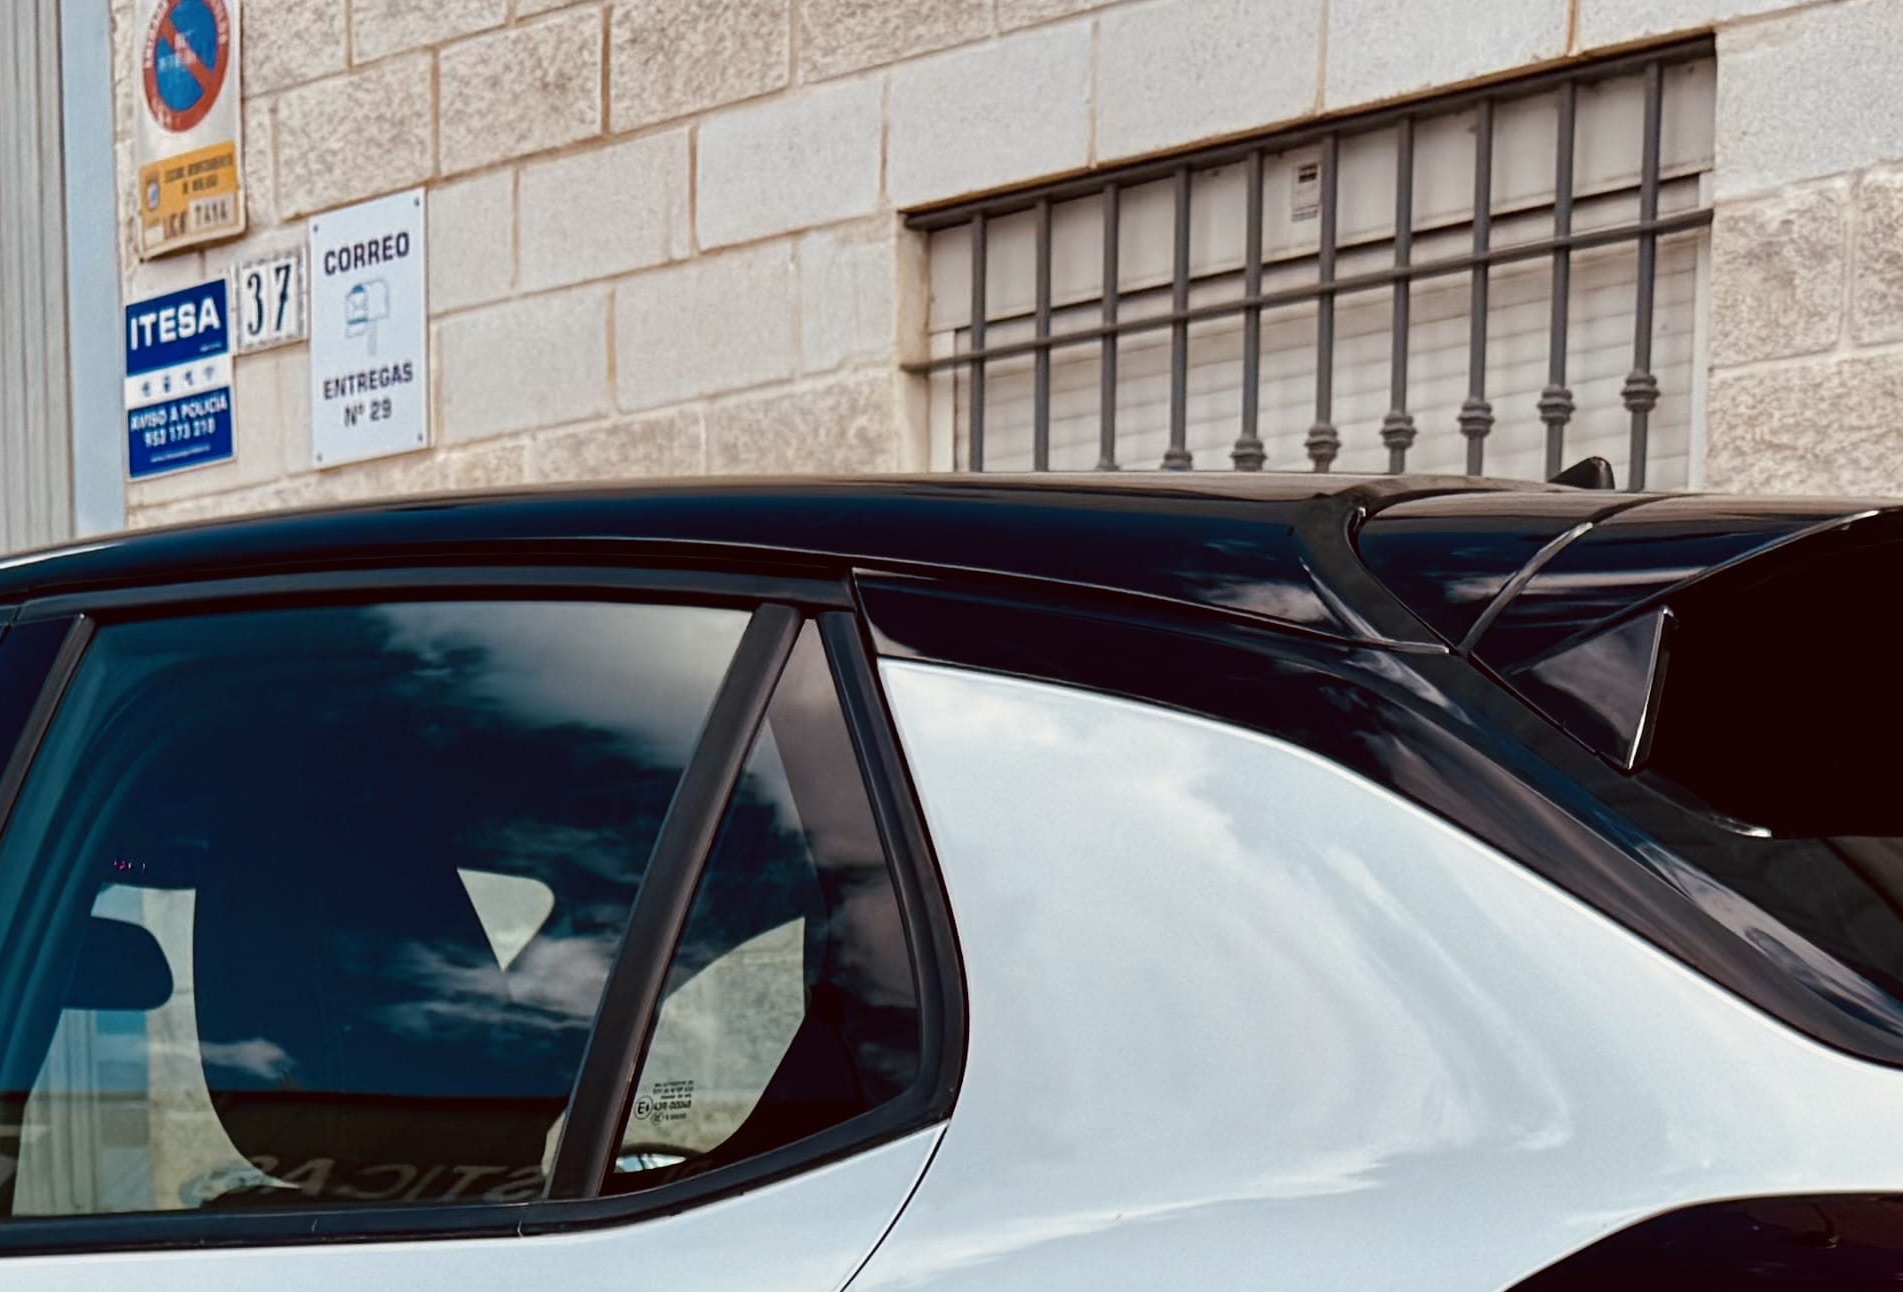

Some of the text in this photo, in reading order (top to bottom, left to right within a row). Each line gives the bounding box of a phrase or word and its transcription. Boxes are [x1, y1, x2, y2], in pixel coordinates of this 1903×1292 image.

[324, 231, 410, 276] CORREO
[246, 264, 291, 336] 37
[131, 296, 220, 350] ITESA
[323, 361, 413, 400] ENTREGAS
[370, 399, 392, 421] 29
